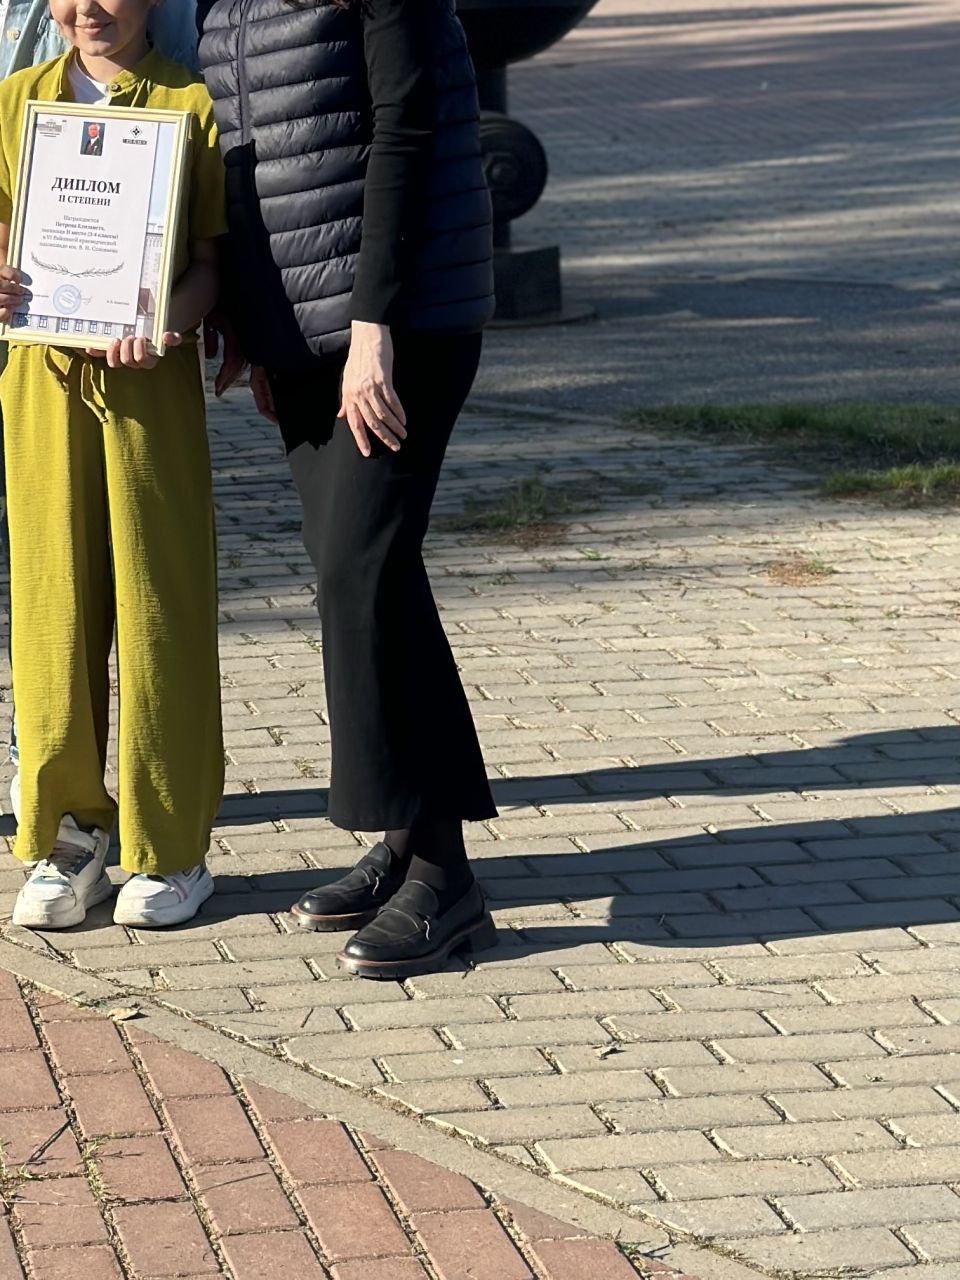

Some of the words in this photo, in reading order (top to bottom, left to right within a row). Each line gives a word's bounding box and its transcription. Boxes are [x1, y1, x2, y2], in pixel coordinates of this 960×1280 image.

[51, 177, 121, 194] ДИПЛОМ
[58, 194, 66, 202] II
[67, 195, 111, 207] СТЕПЕНИ
